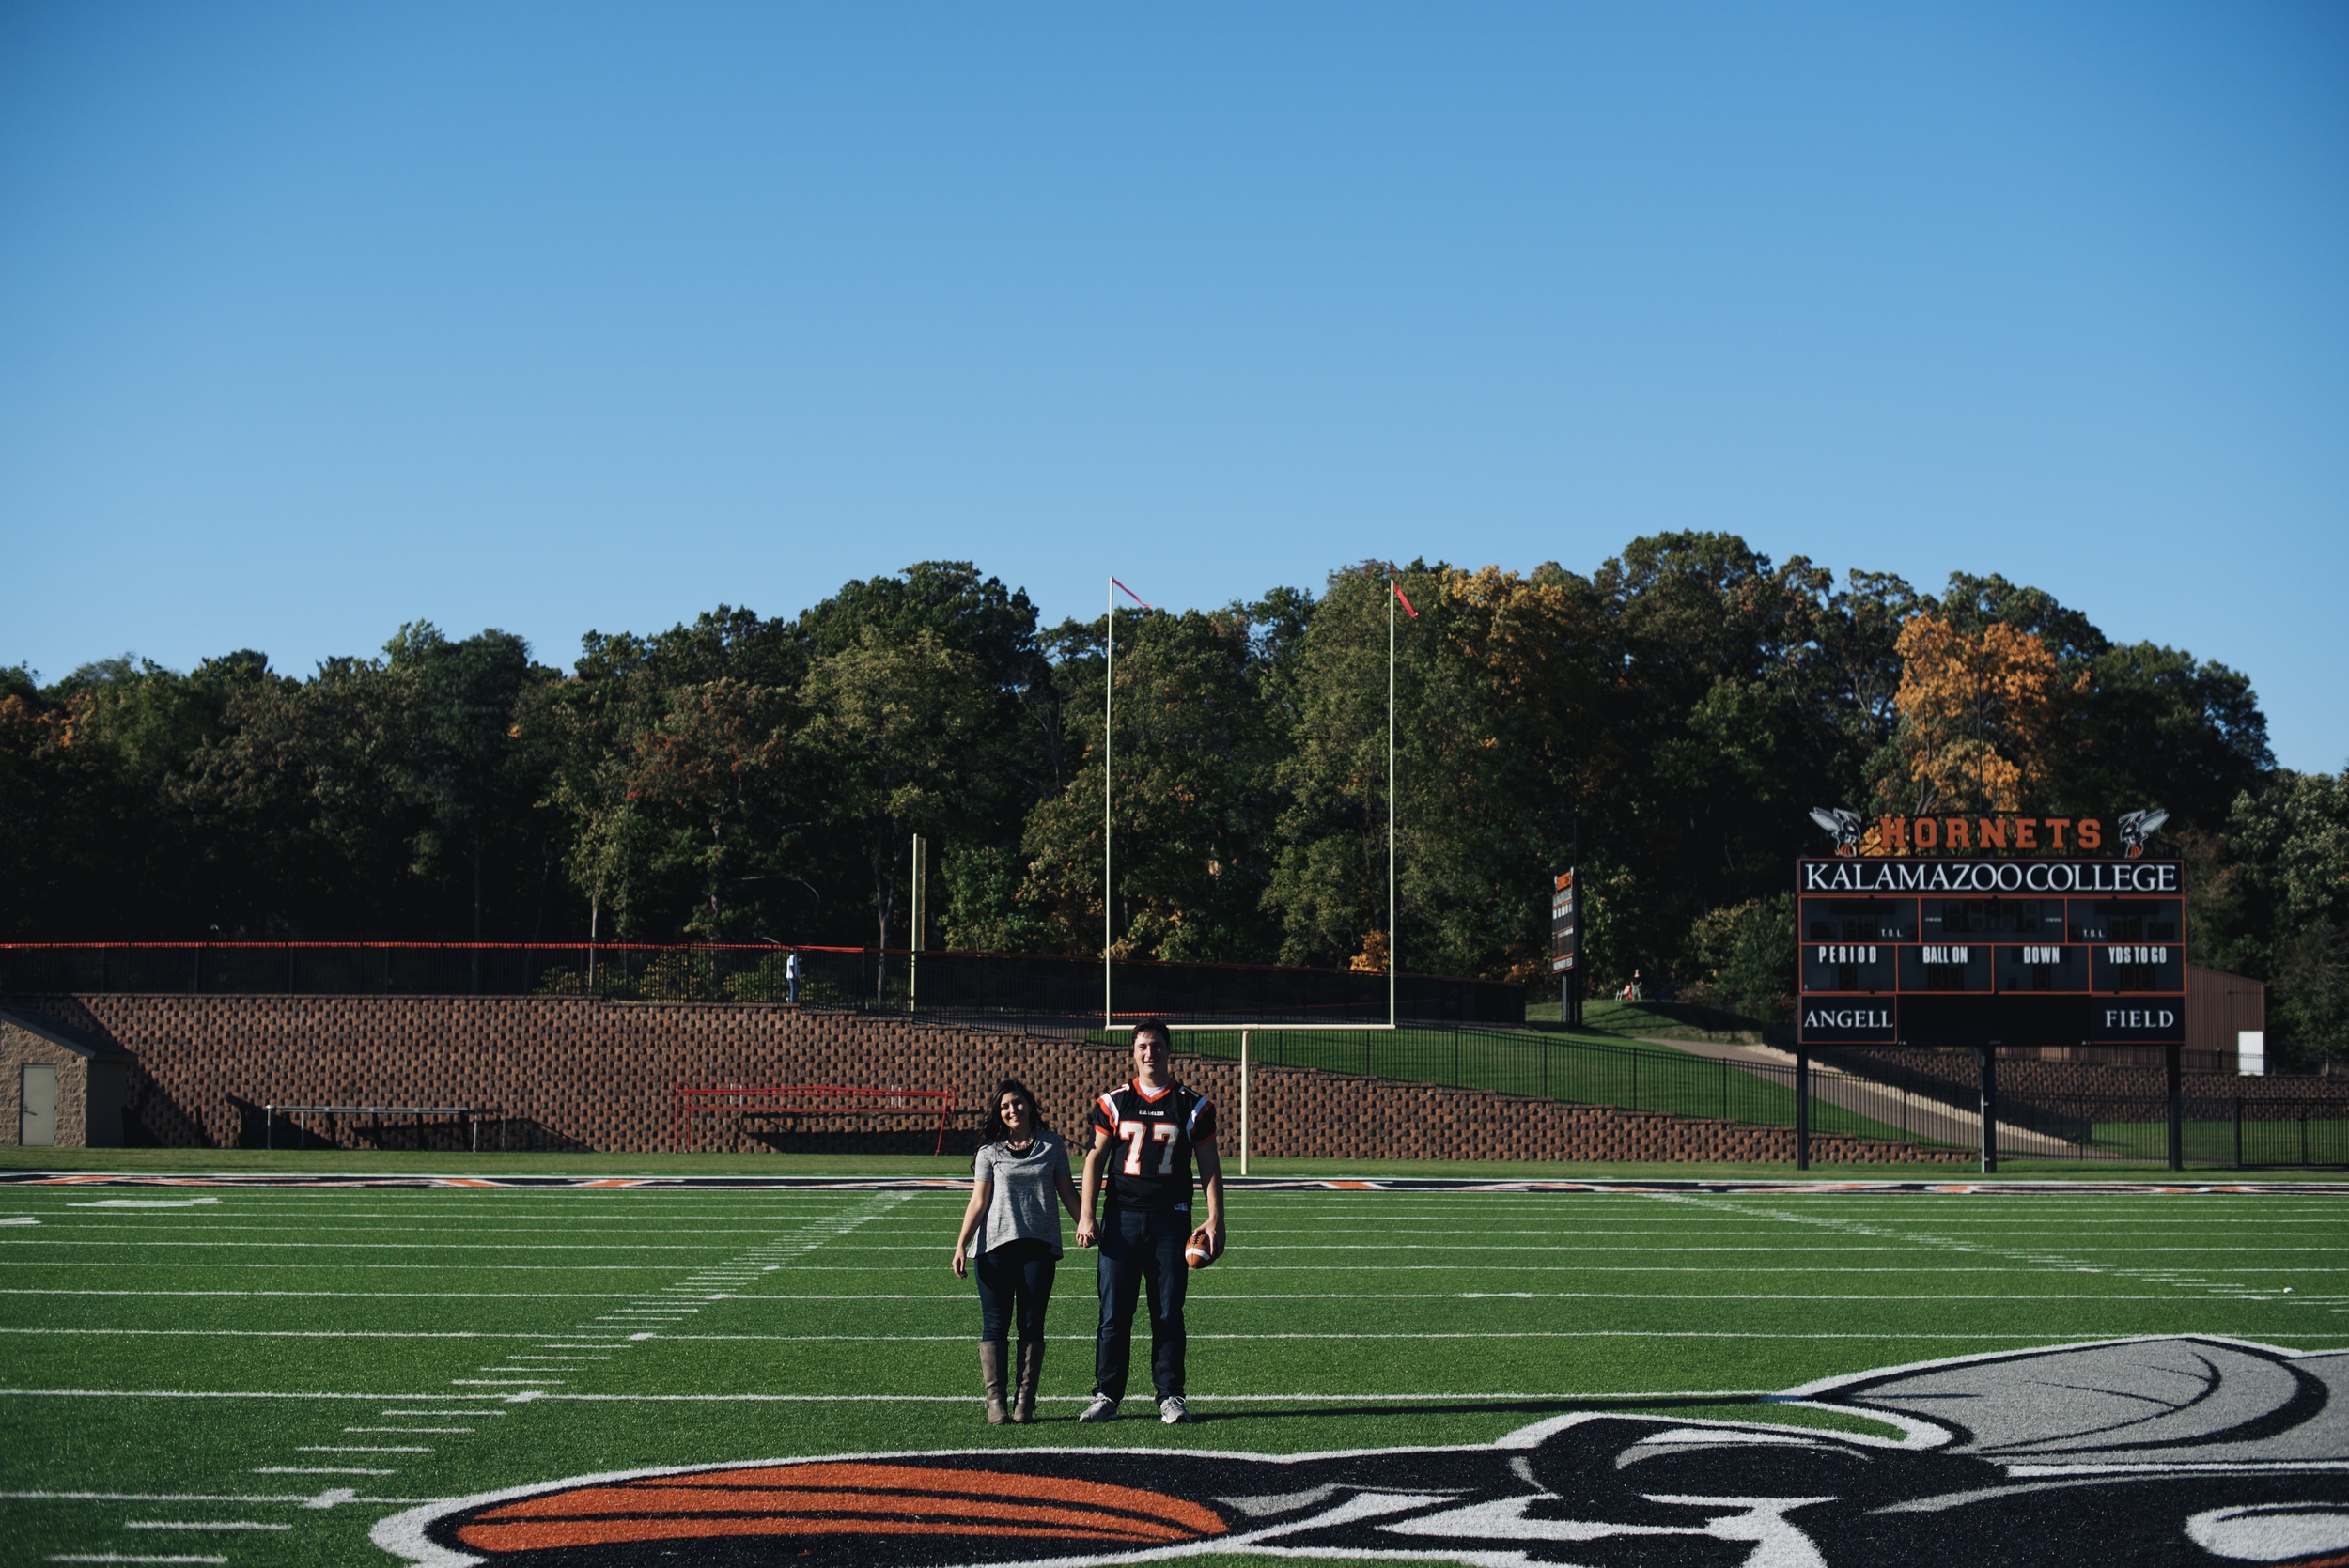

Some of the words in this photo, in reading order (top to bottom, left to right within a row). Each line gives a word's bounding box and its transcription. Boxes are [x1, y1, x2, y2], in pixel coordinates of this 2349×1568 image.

[1880, 817, 2102, 849] HORNETS
[1805, 862, 2023, 891] KALAMAZOO
[2026, 863, 2177, 892] COLLEGE
[1818, 945, 1877, 964] PERIOD
[1922, 945, 1950, 964] BALL
[1952, 945, 1968, 964] ON
[2023, 945, 2061, 965] DOWN
[2108, 945, 2132, 965] YDS
[2134, 945, 2150, 965] TO
[2150, 945, 2168, 965] GO
[1803, 1009, 1894, 1029] ANGELL
[2105, 1009, 2175, 1029] FIELD
[1119, 1120, 1180, 1176] 77
